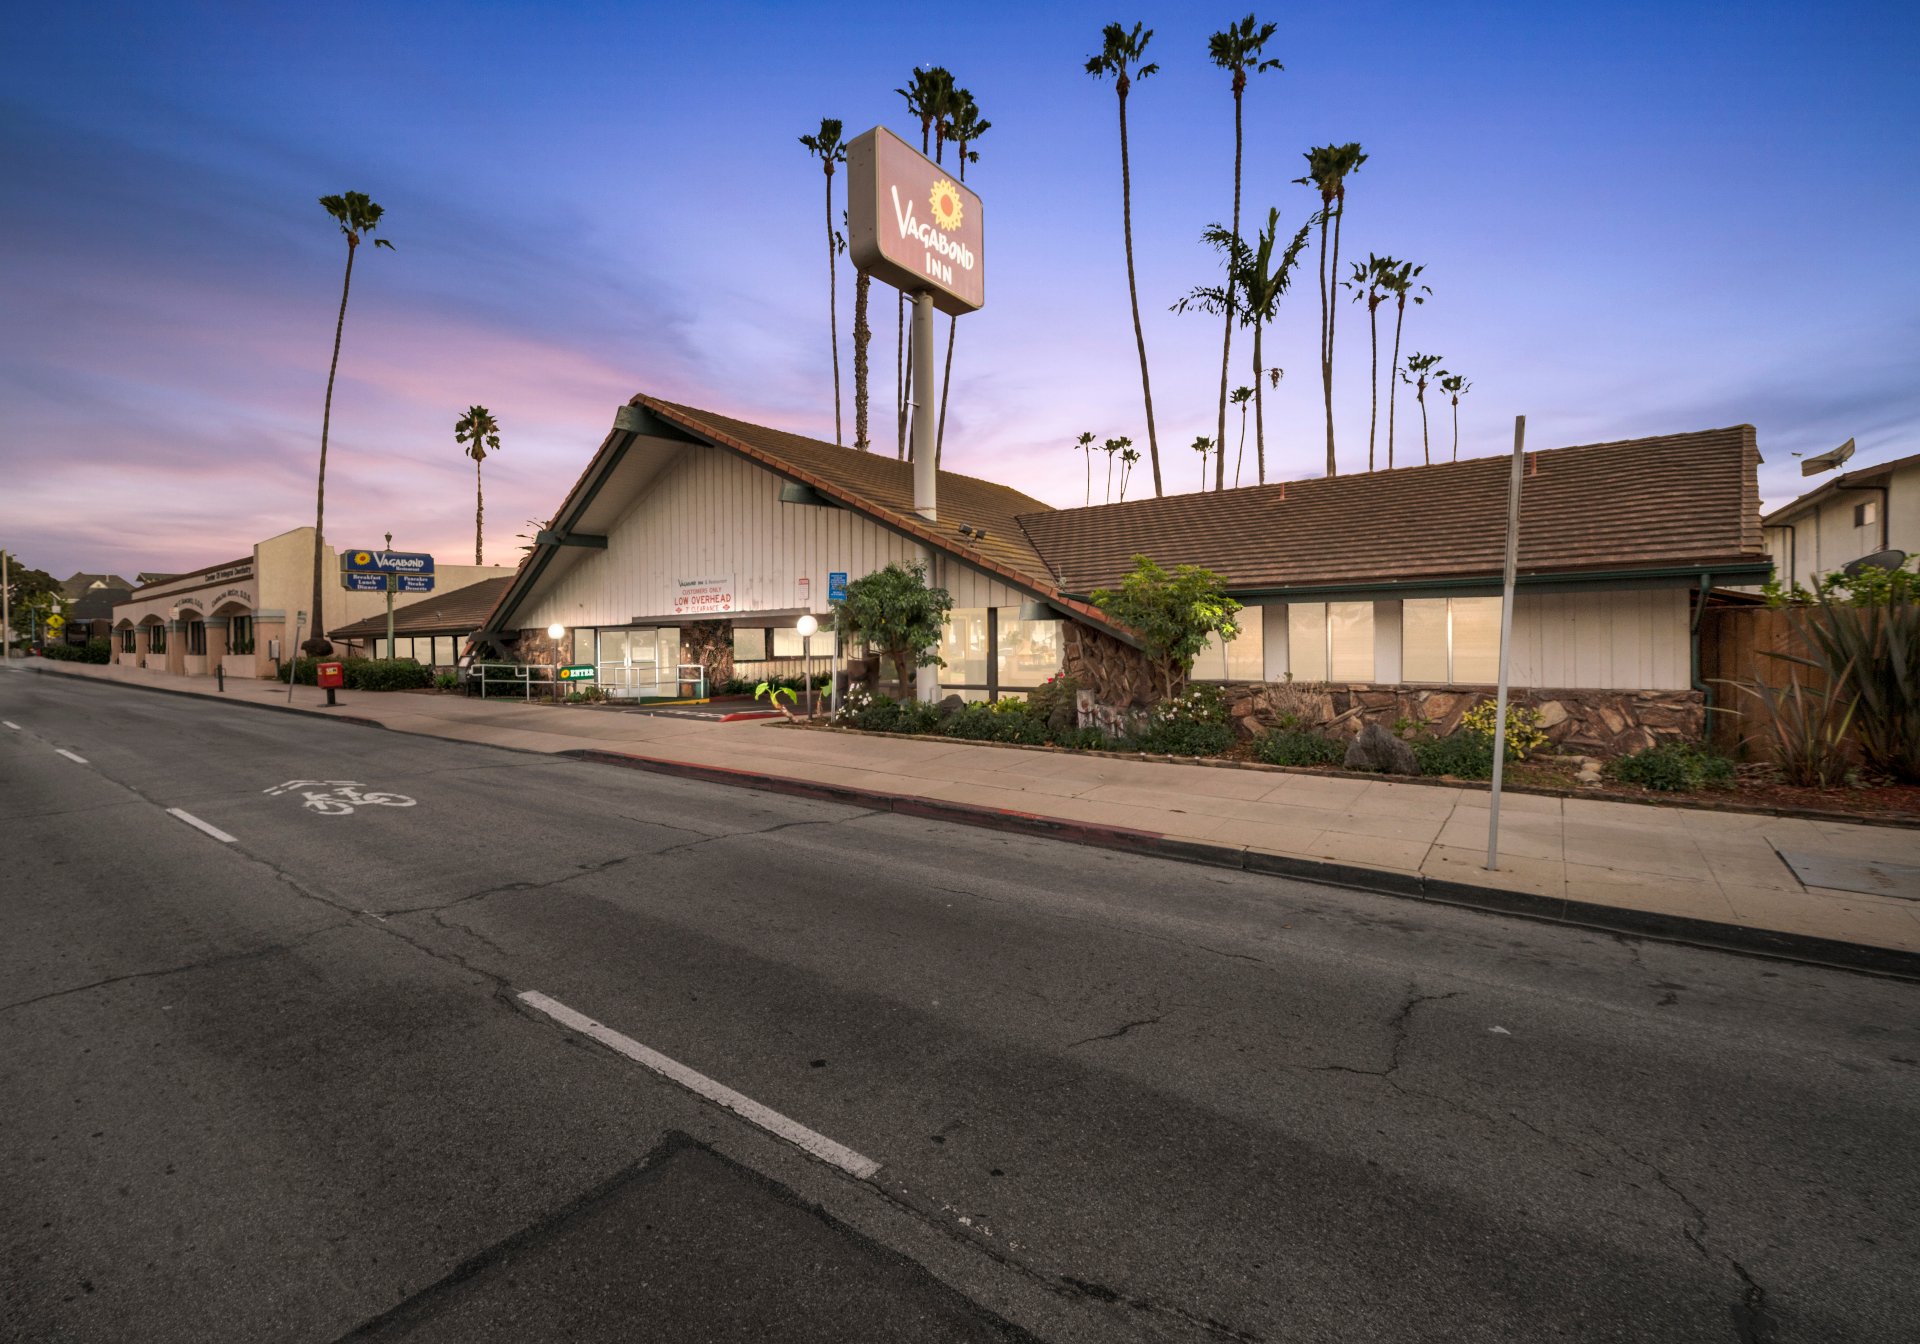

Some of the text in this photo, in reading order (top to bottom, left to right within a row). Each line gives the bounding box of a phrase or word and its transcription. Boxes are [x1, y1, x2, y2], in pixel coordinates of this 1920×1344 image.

[891, 185, 975, 271] VAGABOND
[925, 251, 952, 286] INN
[373, 551, 424, 568] VAGABOND
[674, 593, 732, 606] LOW OVERHEAD
[570, 668, 595, 678] ENTER
